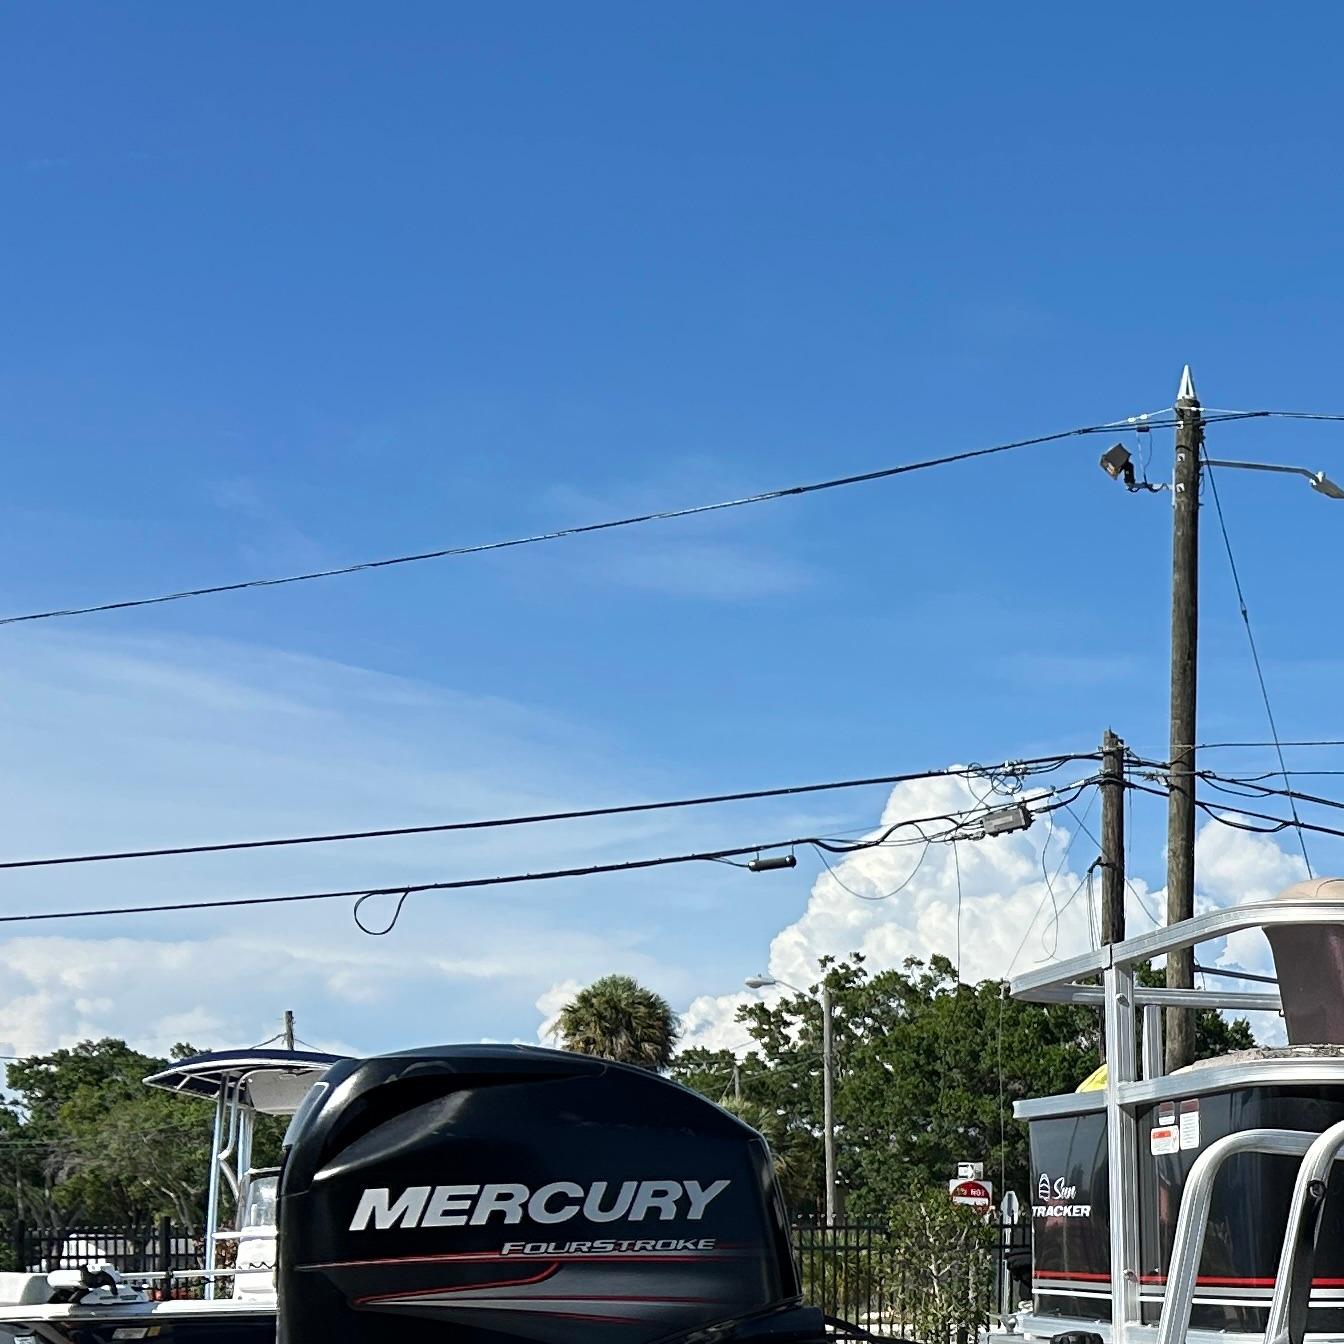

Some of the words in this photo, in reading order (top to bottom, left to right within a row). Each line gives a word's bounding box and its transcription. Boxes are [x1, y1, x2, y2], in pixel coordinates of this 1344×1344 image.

[1052, 1176, 1077, 1200] Sun
[349, 1179, 731, 1231] MERCURY
[1031, 1204, 1091, 1217] TRACKER
